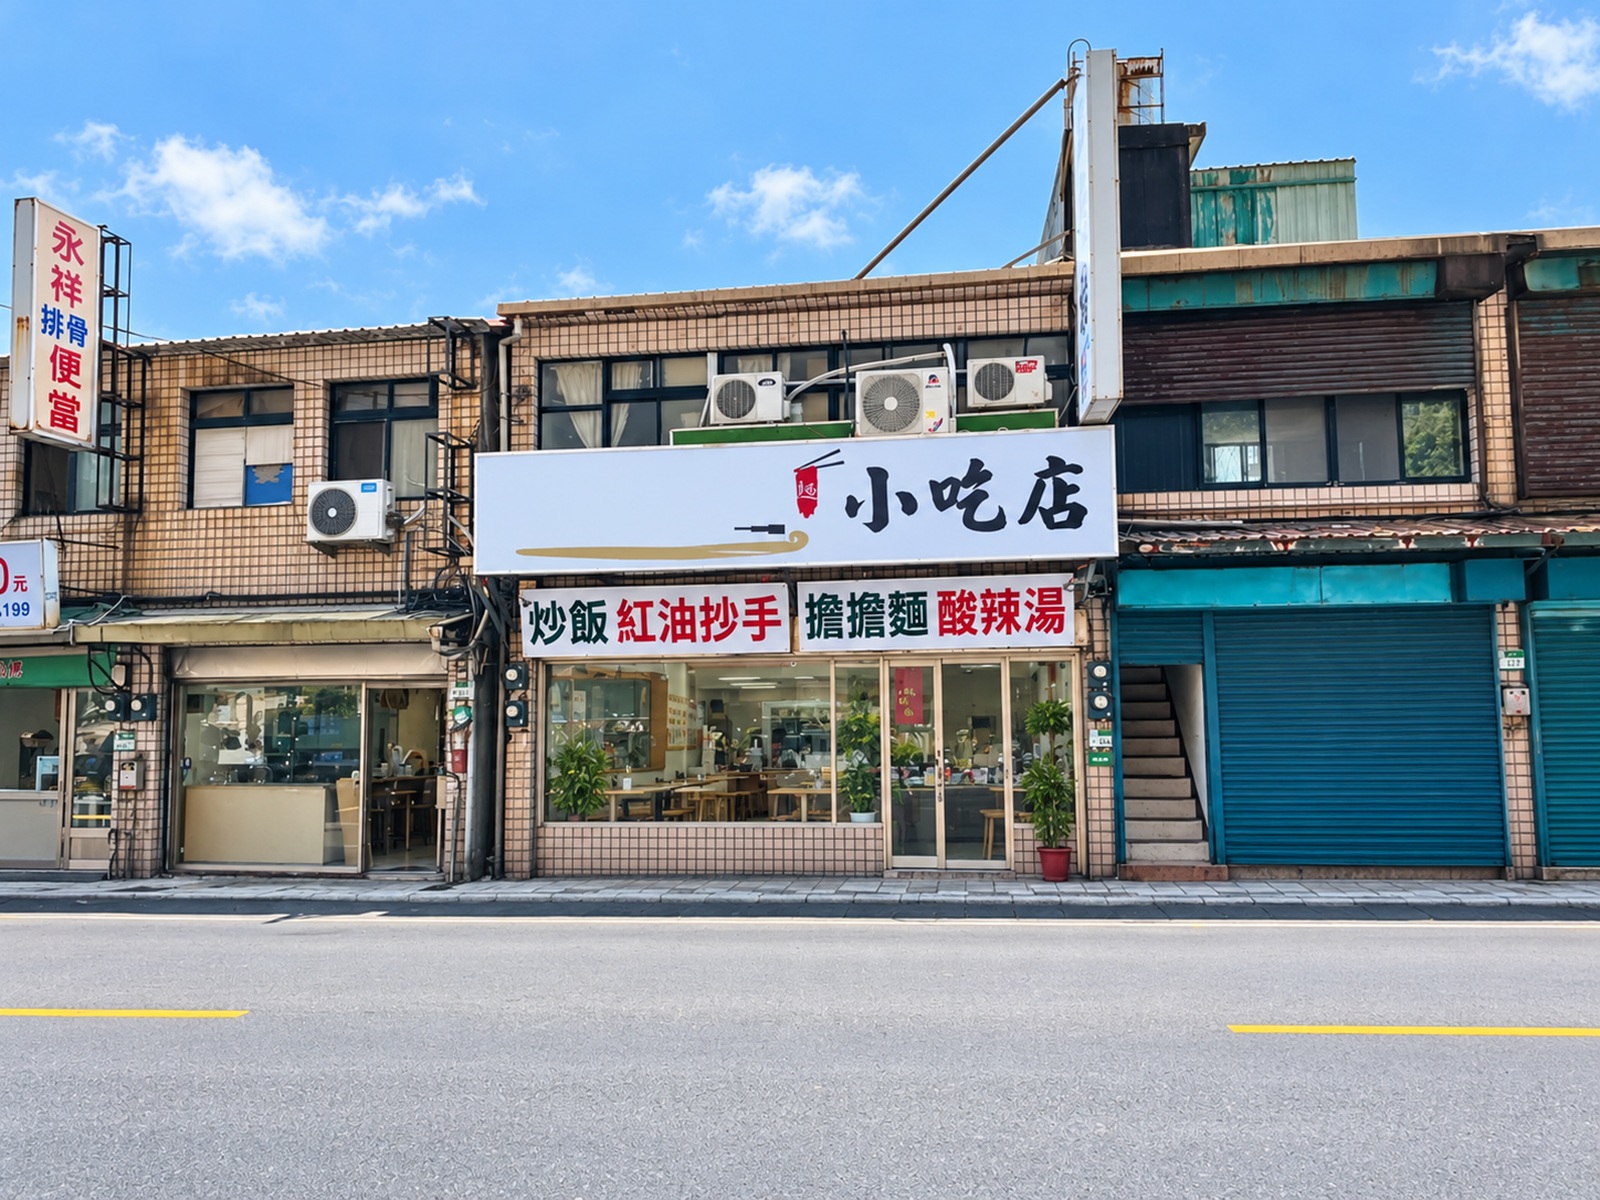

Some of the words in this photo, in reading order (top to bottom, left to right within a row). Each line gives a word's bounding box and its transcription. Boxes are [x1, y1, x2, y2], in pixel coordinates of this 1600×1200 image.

[845, 455, 1088, 533] 小吃店
[529, 599, 609, 645] 炒飯
[616, 594, 782, 644] 紅油抄手
[805, 590, 928, 640] 擔擔麵
[936, 587, 1066, 637] 酸辣湯
